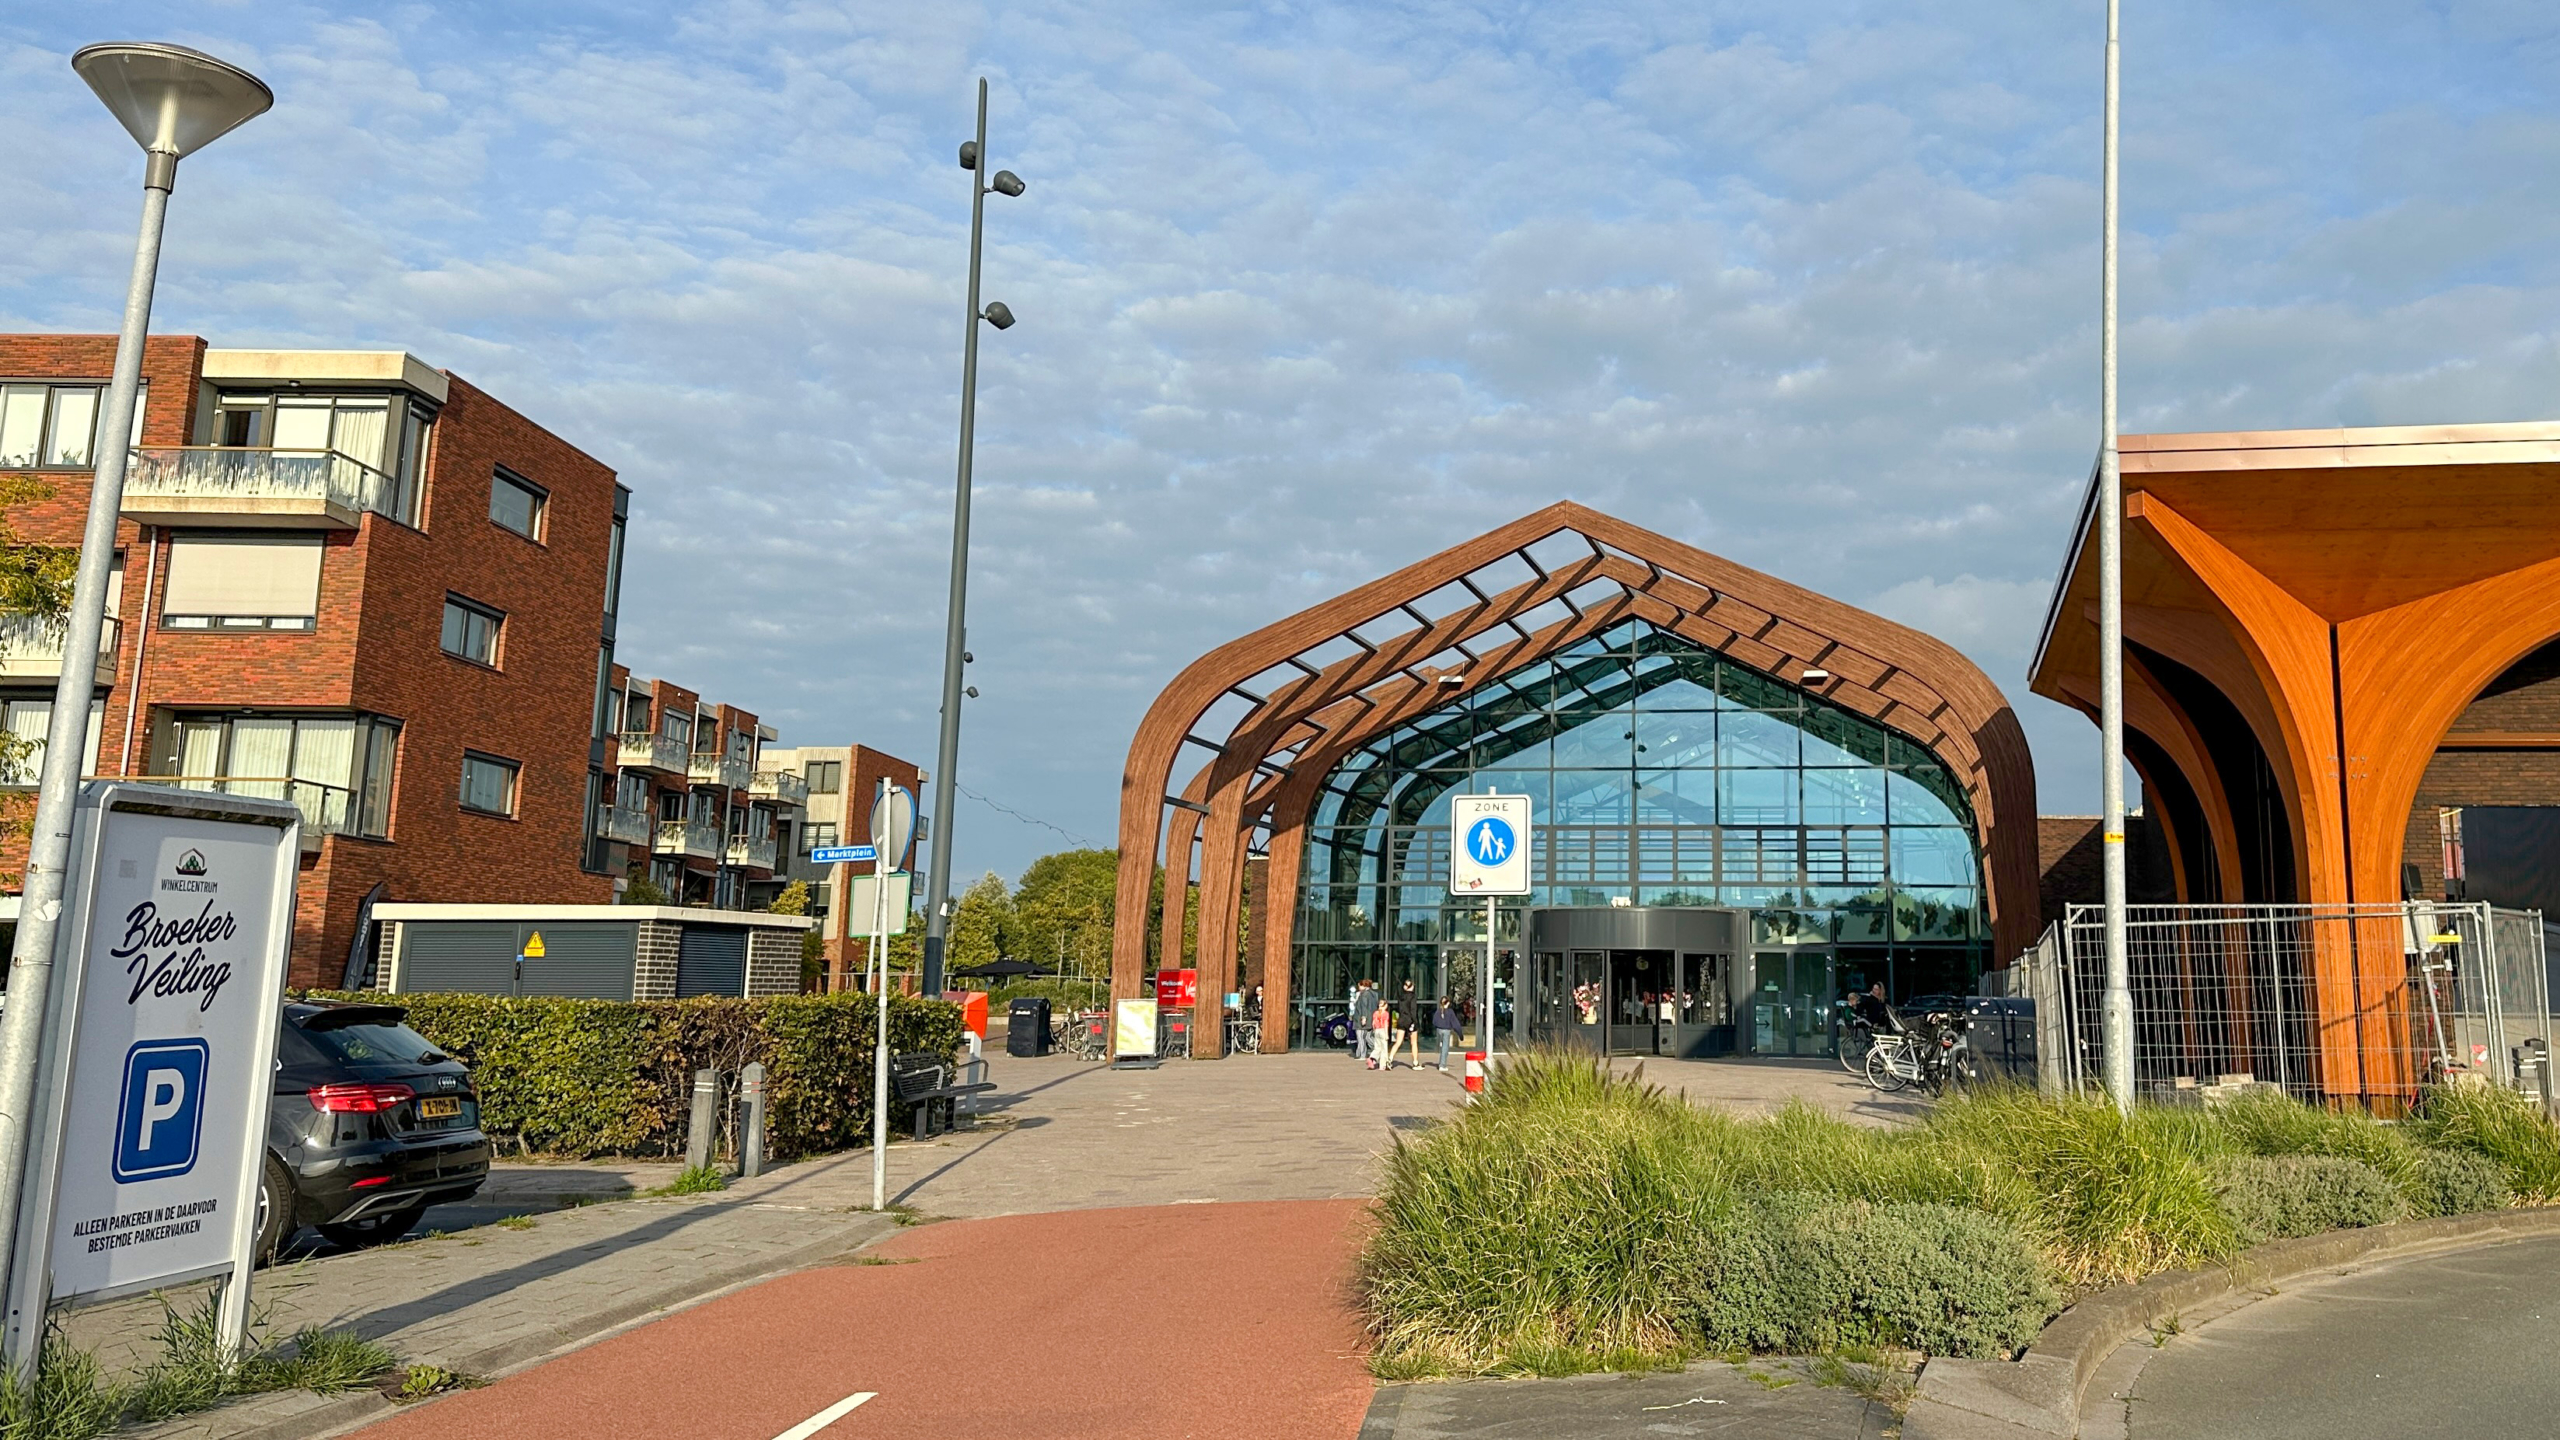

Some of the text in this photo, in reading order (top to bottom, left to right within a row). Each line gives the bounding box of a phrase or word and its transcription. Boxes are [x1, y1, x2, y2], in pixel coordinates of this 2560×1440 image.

[1475, 803, 1509, 812] ZONE
[827, 849, 872, 859] Marktplein
[161, 878, 218, 893] WINKELCENTRUM
[110, 898, 237, 958] Broeker
[127, 946, 232, 1013] Veiling
[138, 1067, 185, 1151] P
[73, 1199, 217, 1238] ALLEEN PARKEREN IN DE DAARVOOR
[87, 1219, 201, 1254] BESTEMDE PARKEERVAKKEN
